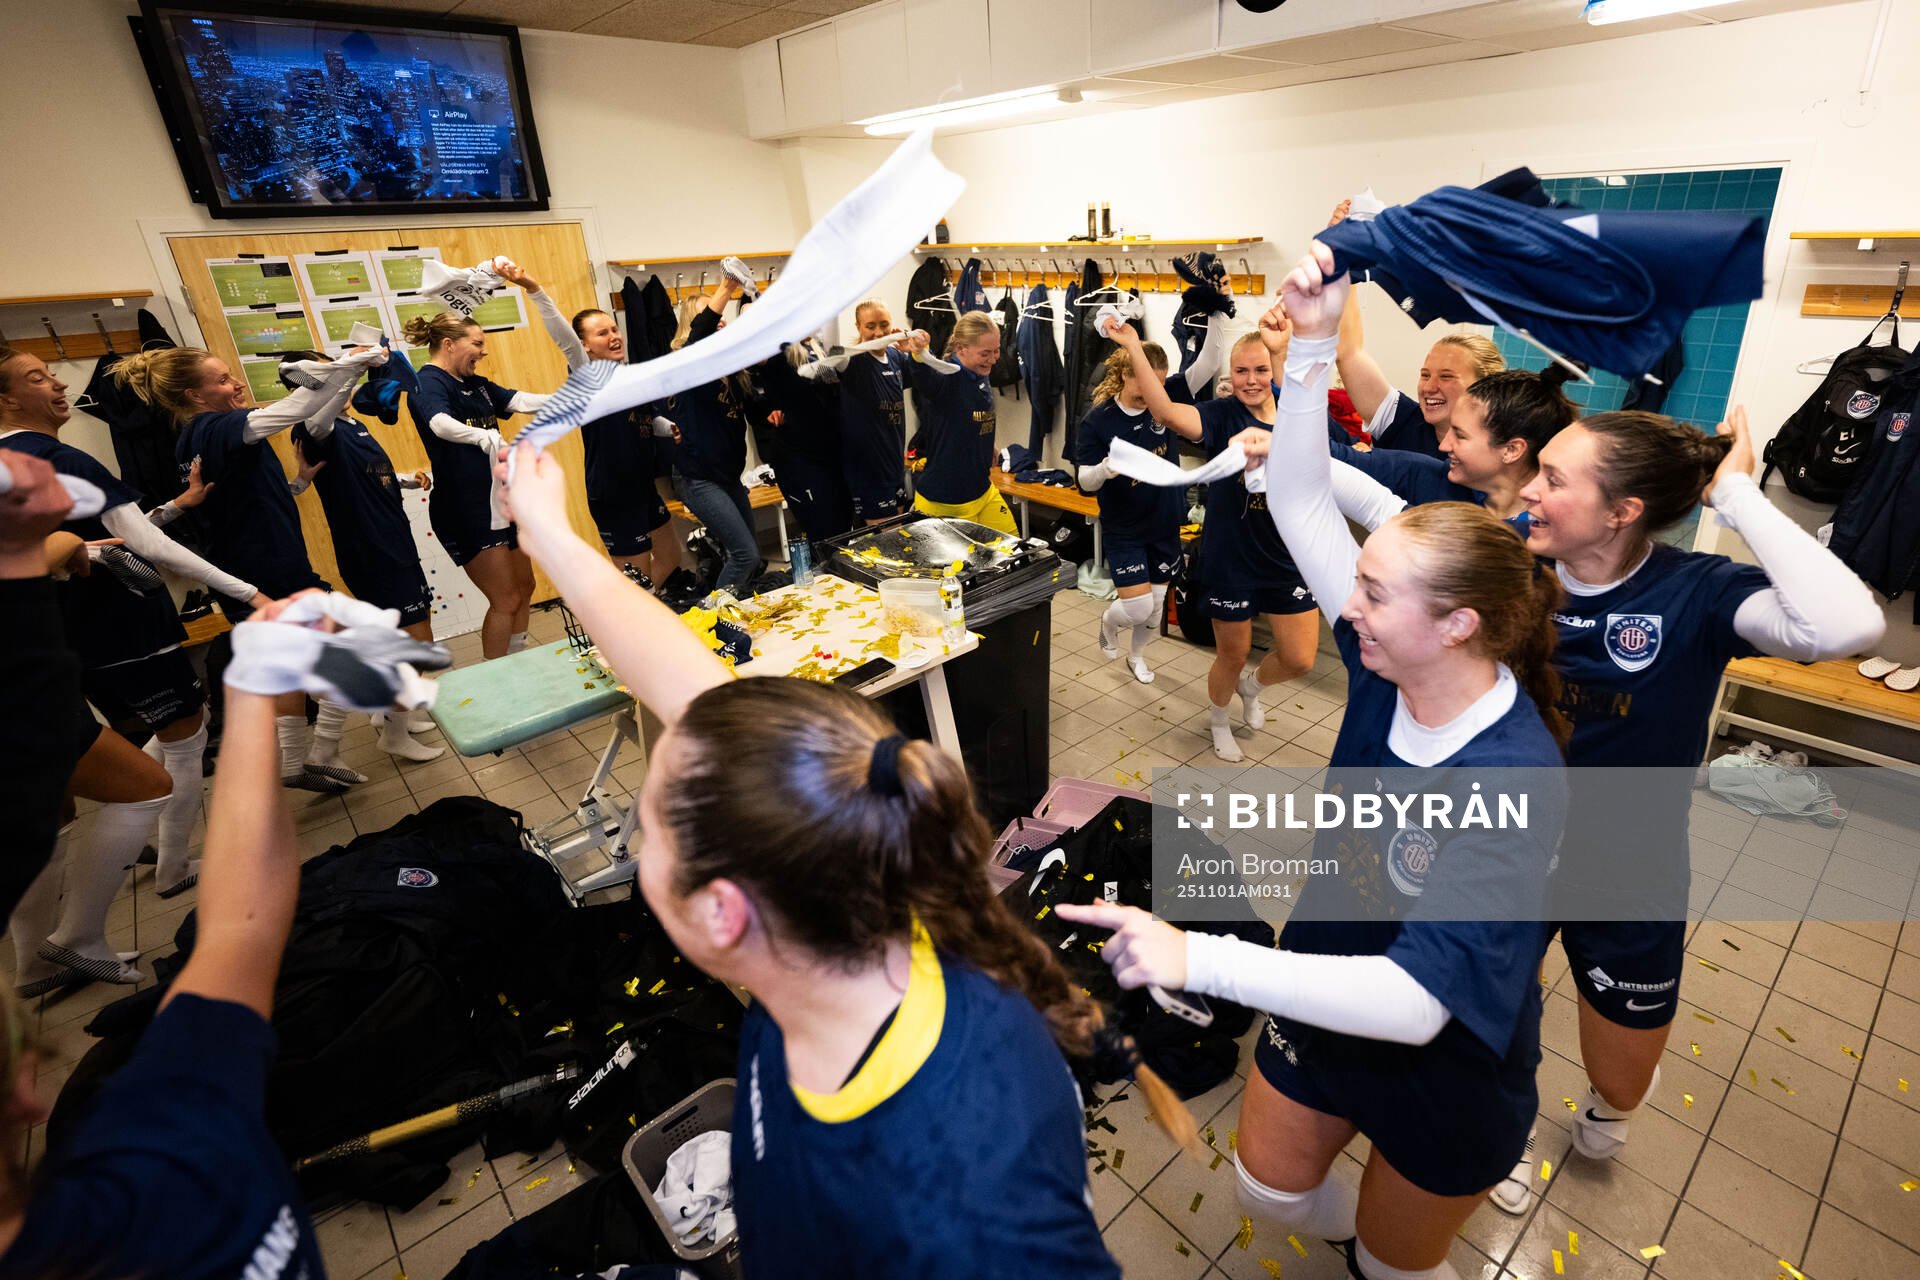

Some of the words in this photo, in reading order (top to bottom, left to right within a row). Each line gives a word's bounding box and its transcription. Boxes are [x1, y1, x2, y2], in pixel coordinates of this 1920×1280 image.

[444, 111, 468, 120] AirPlay
[441, 168, 485, 176] Omklädningsrum
[1615, 618, 1654, 632] UNITED
